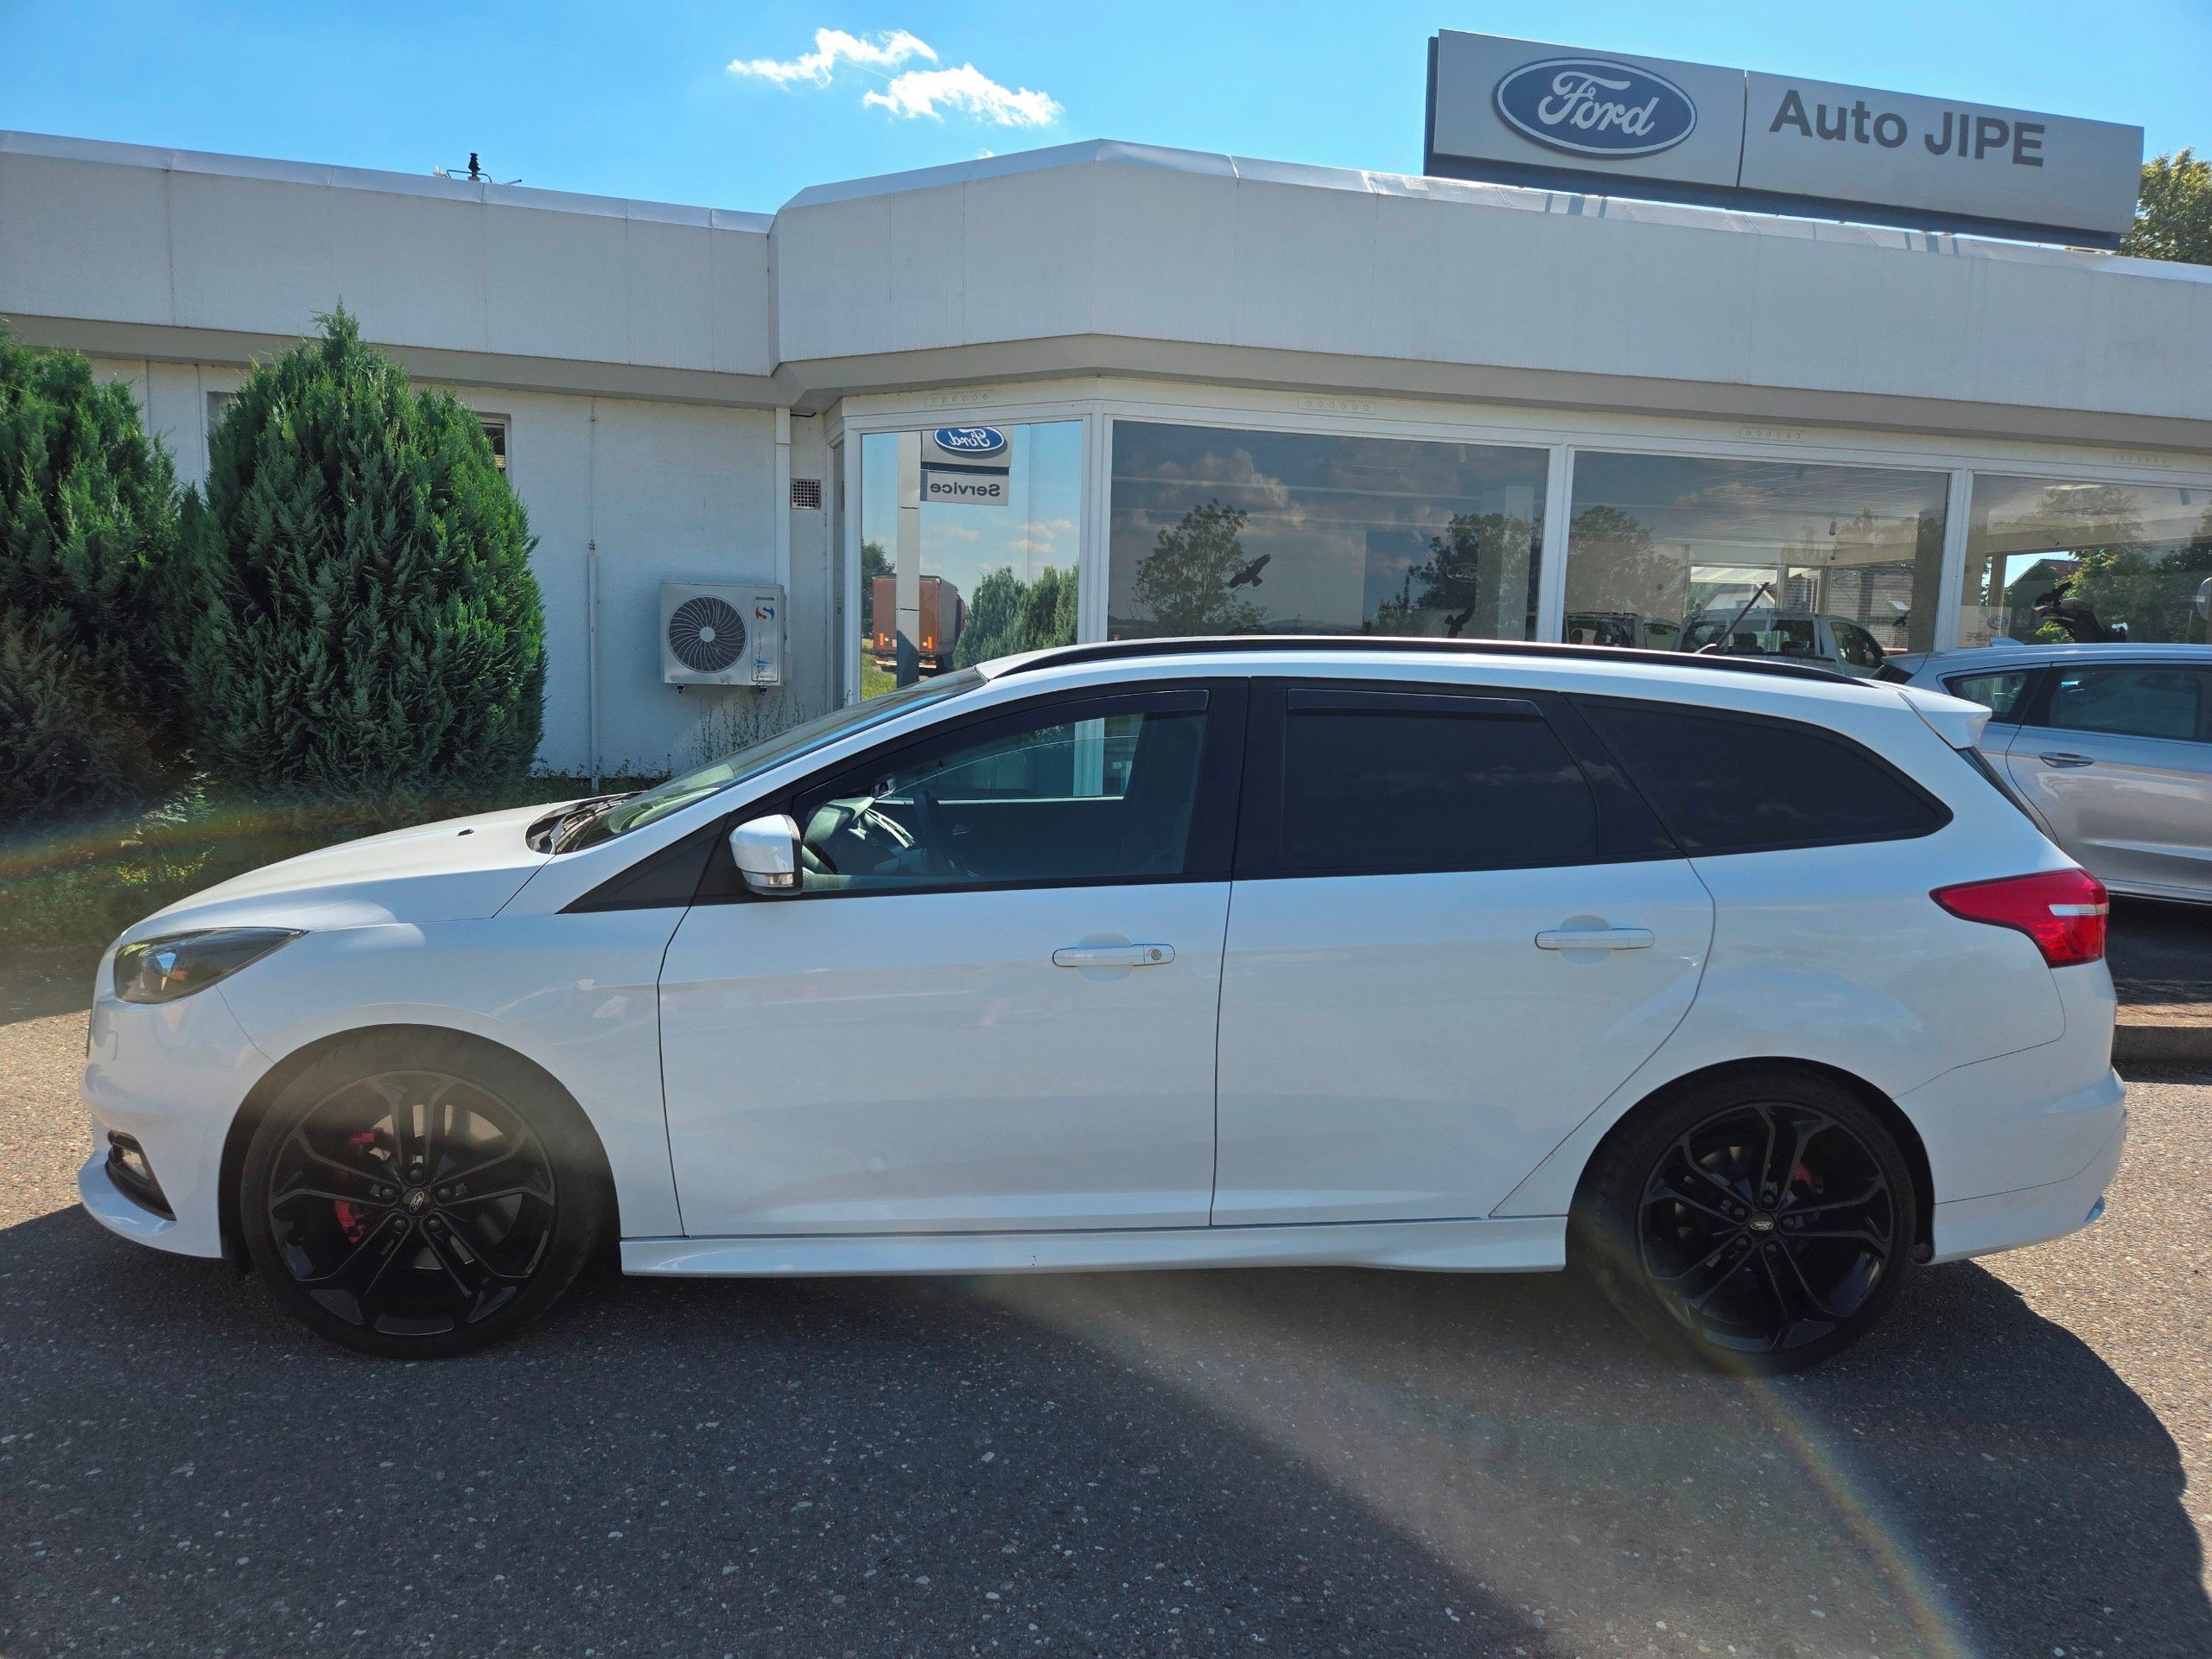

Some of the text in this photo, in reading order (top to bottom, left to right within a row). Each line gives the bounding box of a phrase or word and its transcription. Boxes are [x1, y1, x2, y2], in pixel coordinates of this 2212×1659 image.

[1537, 71, 1660, 137] Ford
[1769, 89, 2045, 168] Auto JIPE
